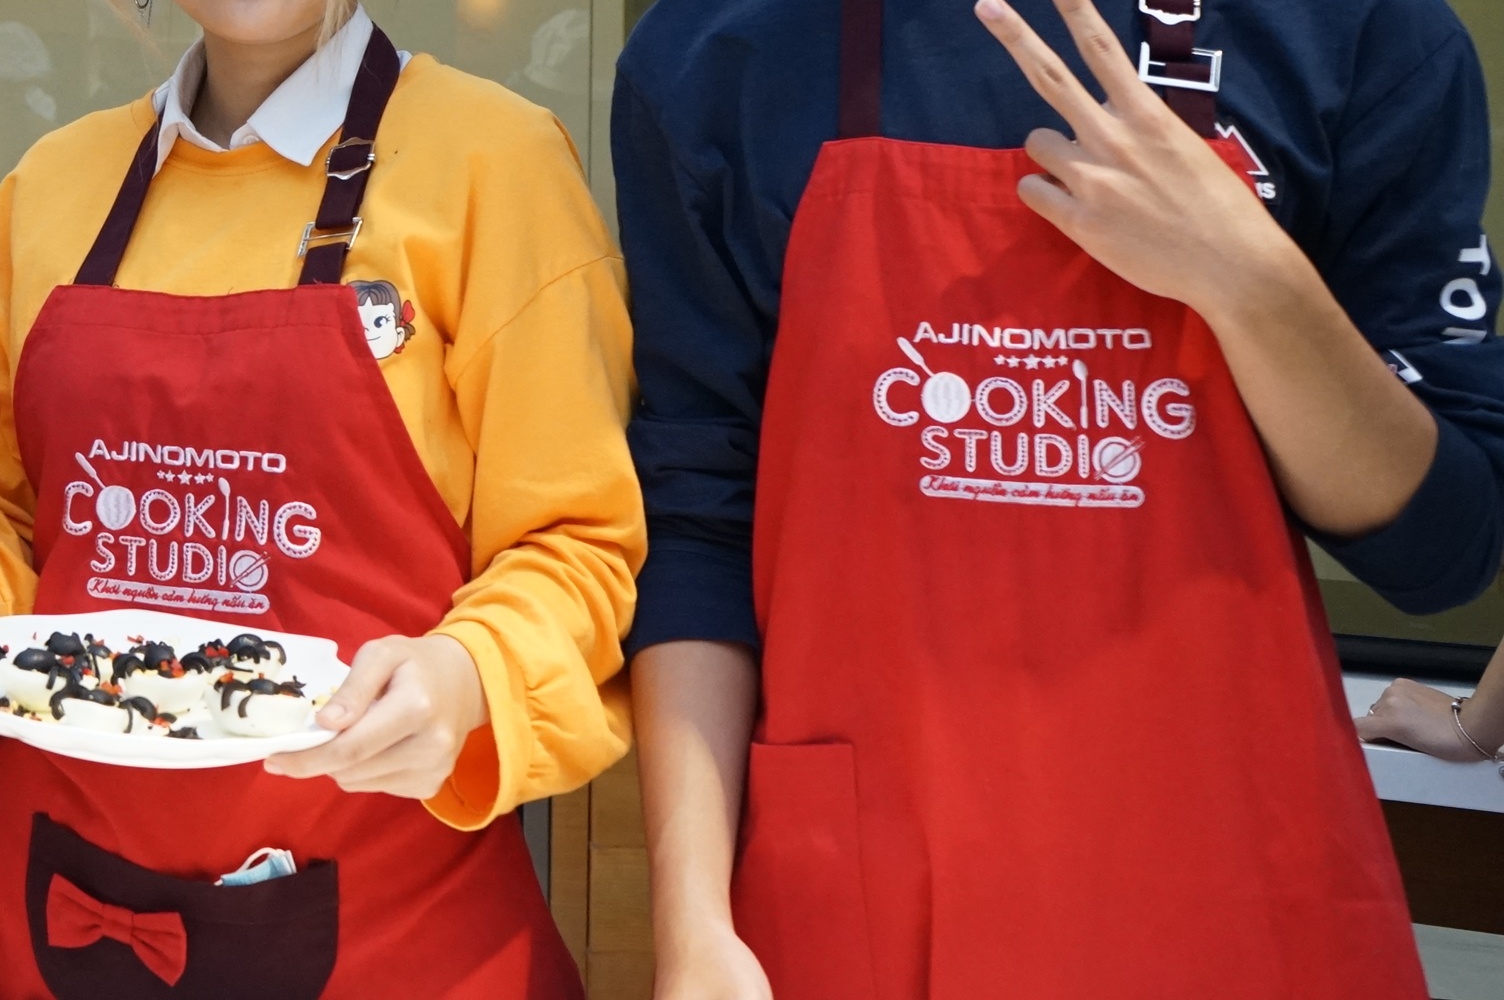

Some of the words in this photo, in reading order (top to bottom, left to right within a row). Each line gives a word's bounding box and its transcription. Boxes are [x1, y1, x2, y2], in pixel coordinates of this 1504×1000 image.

[913, 321, 1152, 350] AJINOMOTO
[873, 359, 1195, 439] COOKING
[89, 439, 286, 473] AJINOMOTO
[919, 426, 1143, 483] STUDIO
[62, 477, 321, 558] COOKING
[90, 532, 268, 592] STUDIO
